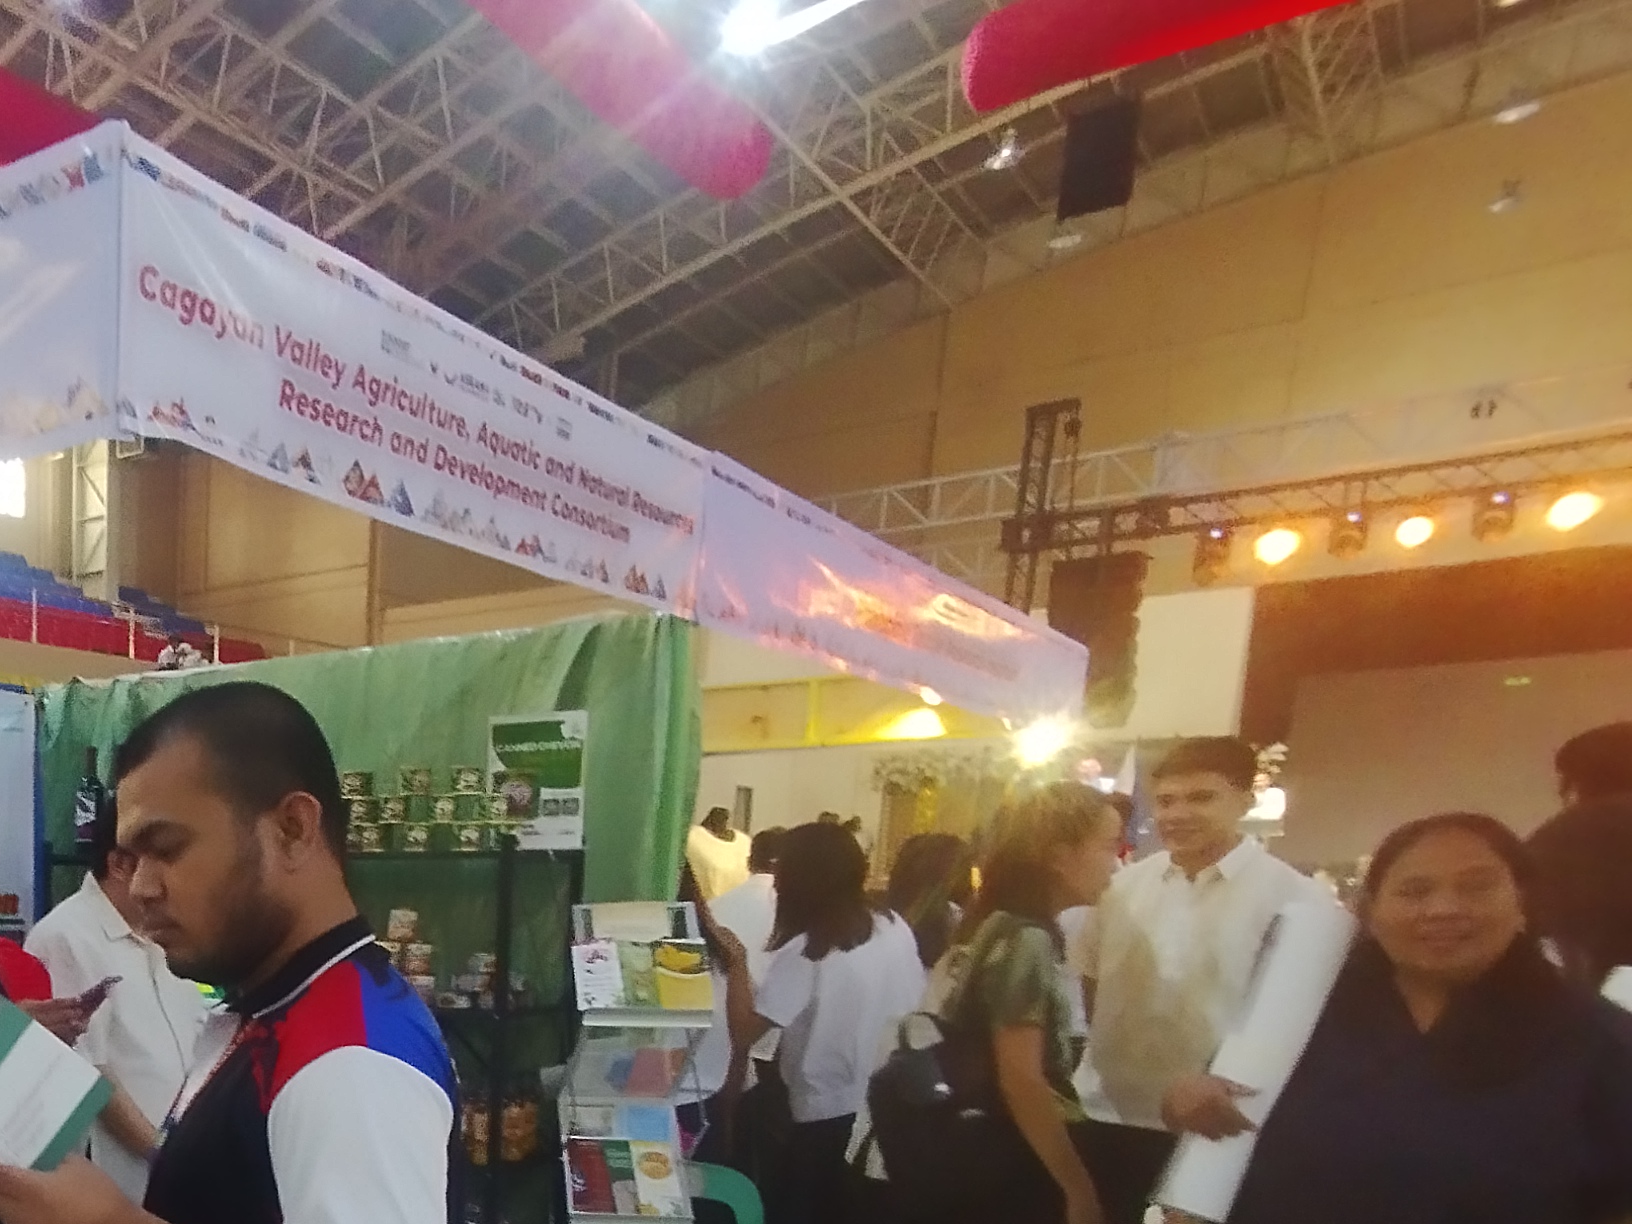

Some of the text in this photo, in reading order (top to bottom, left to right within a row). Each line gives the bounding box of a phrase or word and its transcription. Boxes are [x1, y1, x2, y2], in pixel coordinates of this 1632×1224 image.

[139, 264, 265, 350] Cagayan
[275, 324, 347, 390] Valley
[352, 363, 470, 441] Agriculture,
[476, 421, 541, 471] Aquatic
[545, 455, 574, 485] and
[578, 465, 630, 507] Natural
[279, 378, 383, 447] Research
[389, 430, 429, 464] and
[433, 444, 547, 513] Development
[552, 492, 630, 544] Consortium
